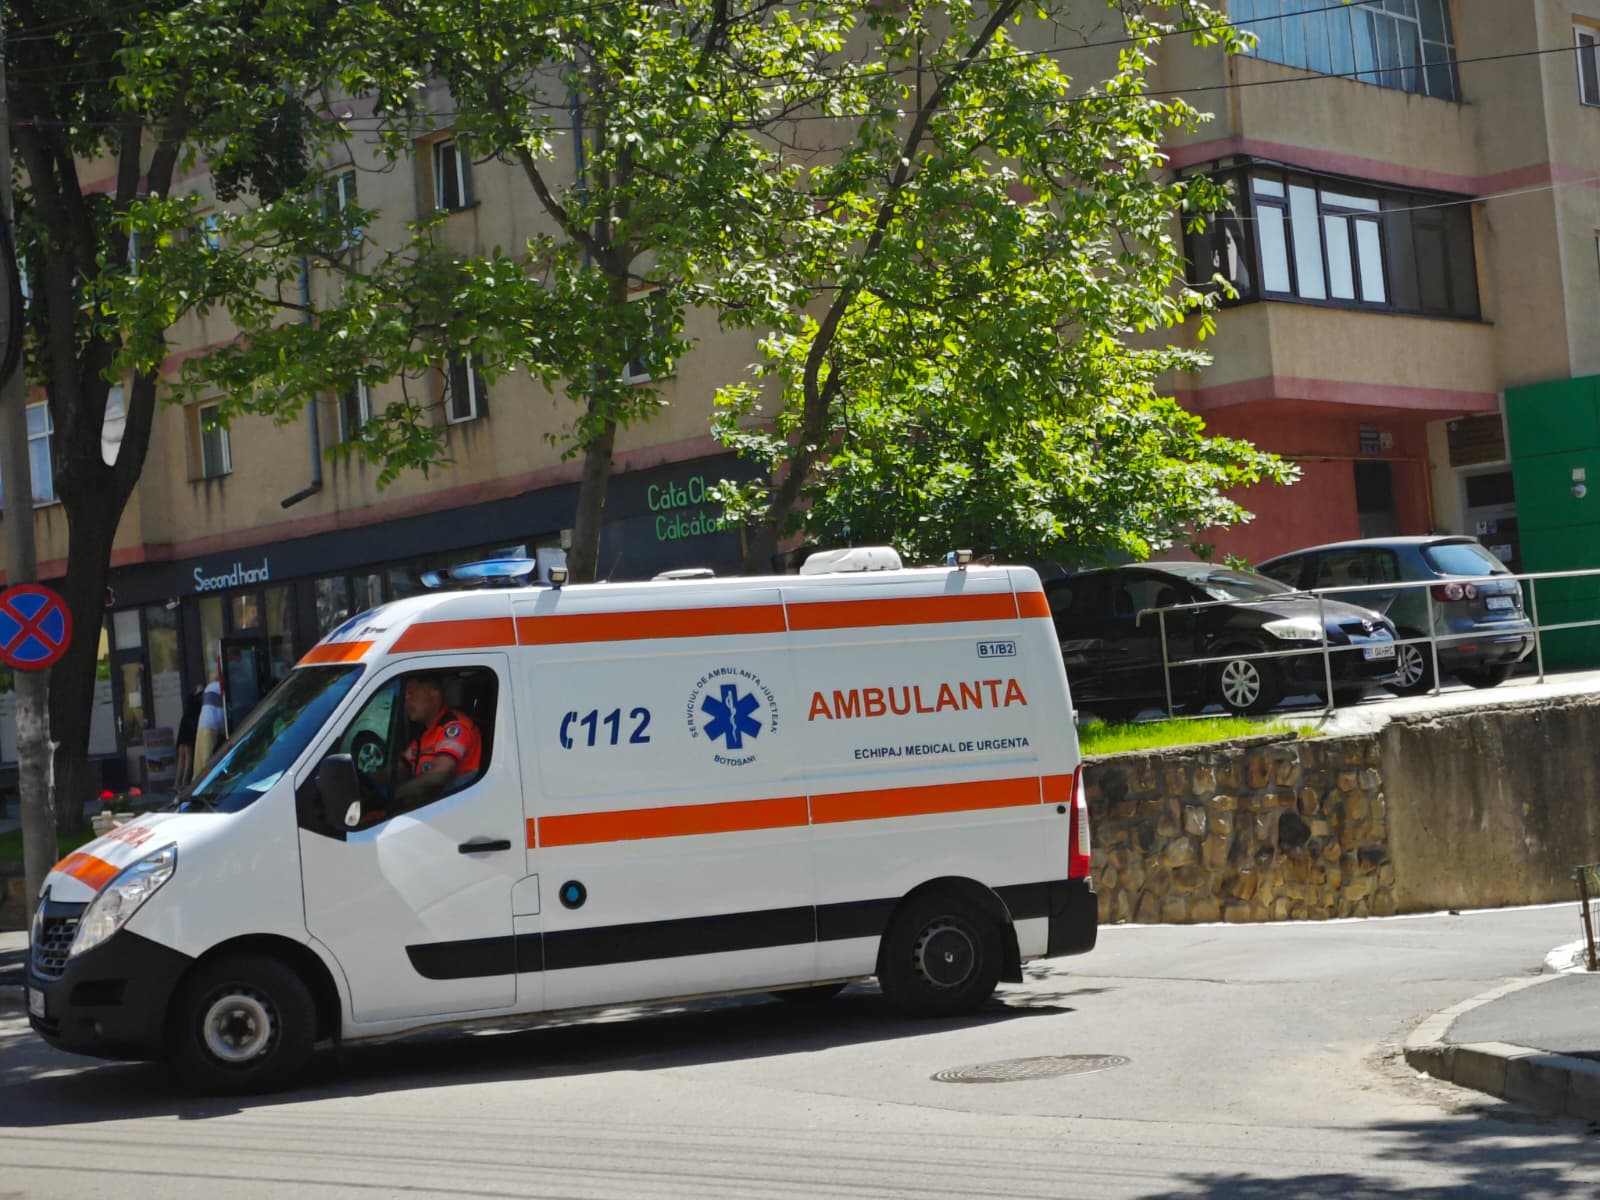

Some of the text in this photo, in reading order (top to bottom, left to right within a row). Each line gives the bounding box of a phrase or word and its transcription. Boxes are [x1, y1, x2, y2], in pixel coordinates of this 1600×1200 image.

[979, 643, 1014, 655] B1/B2
[687, 667, 779, 738] SERVICIUL DE AMBULANTA JUDETEAN
[808, 678, 1028, 722] AMBULANTA
[580, 707, 651, 747] 112
[714, 754, 757, 767] BOTOSANI
[854, 737, 1030, 760] ECHIPAJ MEDICAL DE URGENTA
